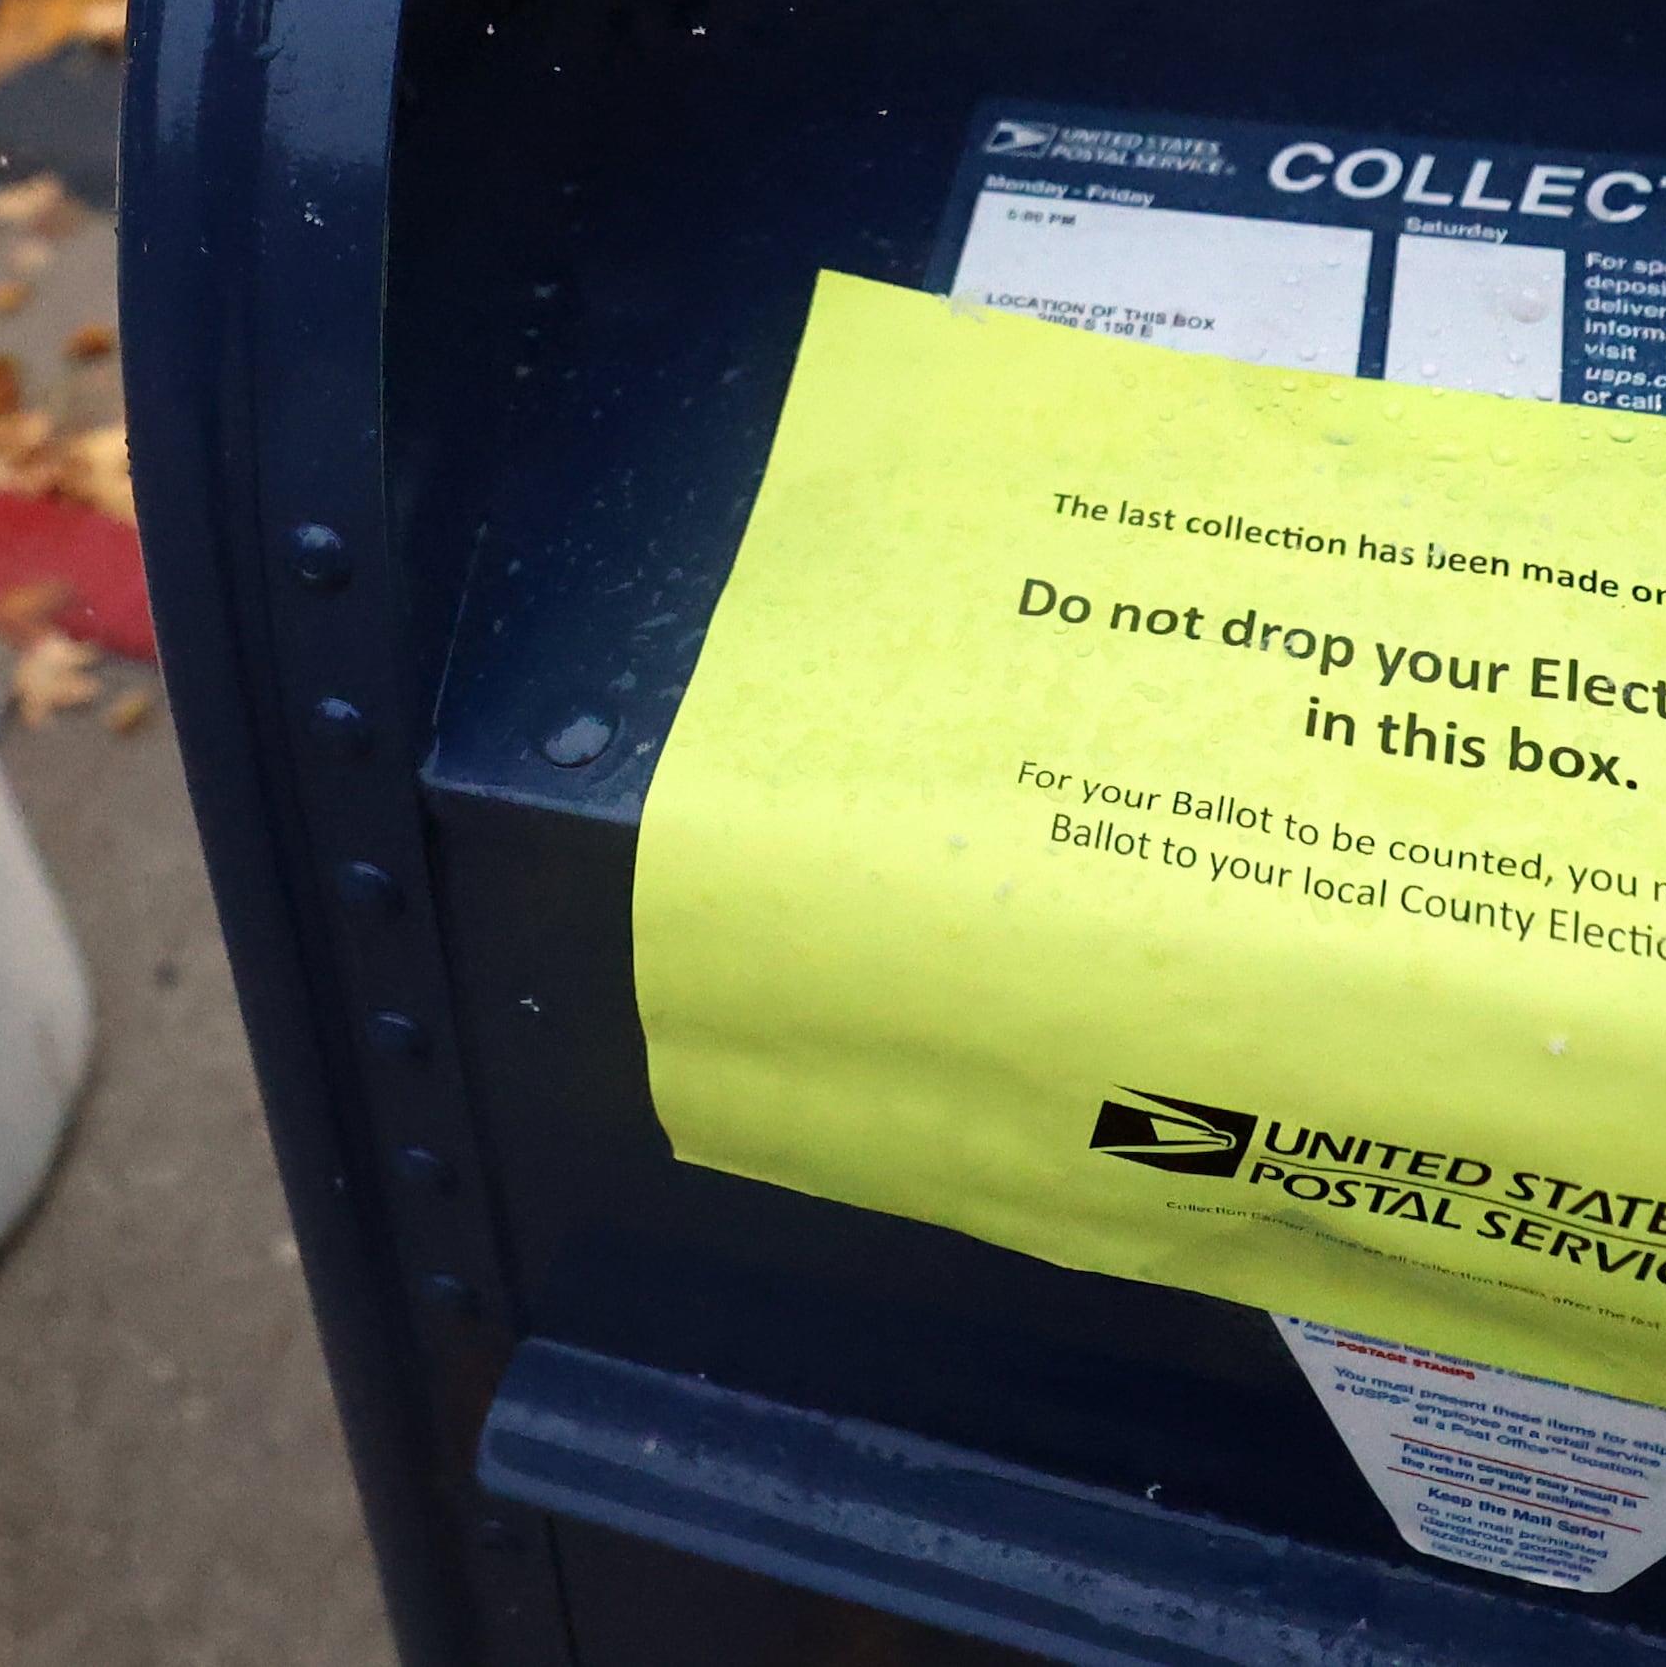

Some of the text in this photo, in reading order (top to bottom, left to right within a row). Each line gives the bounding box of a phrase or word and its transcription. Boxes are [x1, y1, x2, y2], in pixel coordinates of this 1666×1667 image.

[1060, 127, 1223, 156] UNITED STATES
[985, 173, 1069, 199] Monday
[1086, 183, 1155, 207] Friday
[1404, 215, 1508, 245] Saturday
[1585, 251, 1628, 270] For
[986, 291, 1215, 331] LOCATION OF THIS BOX
[1584, 342, 1637, 362] visit
[1583, 389, 1663, 412] or call
[1052, 492, 1109, 522] The
[1117, 500, 1176, 533] last
[1185, 514, 1347, 556] collection
[1357, 533, 1415, 567] has
[1426, 542, 1510, 577] been
[1522, 560, 1620, 598] made
[1018, 577, 1092, 624] Do
[1109, 601, 1204, 641] not
[1221, 609, 1356, 676] drop
[1375, 642, 1510, 694] your
[1305, 696, 1639, 790] in this box.
[1017, 760, 1073, 791] For
[1082, 777, 1162, 812] your
[1171, 790, 1272, 834] Ballot
[1283, 813, 1320, 846] to
[1332, 822, 1376, 855] be
[1389, 839, 1555, 888] counted,
[1567, 862, 1639, 897] you
[1051, 812, 1152, 860] Ballot
[1163, 836, 1198, 869] to
[1209, 850, 1293, 888] your
[1304, 866, 1387, 908] local
[1400, 884, 1535, 942] County
[1263, 1121, 1494, 1187] UNITED
[1166, 1201, 1247, 1218] Collection
[1249, 1161, 1463, 1231] POSTAL
[1336, 1339, 1408, 1365] POSTAGE
[1412, 1358, 1476, 1381] STAMPS
[1333, 1365, 1367, 1383] You
[1371, 1375, 1415, 1395] must
[1419, 1387, 1487, 1413] present
[1492, 1405, 1542, 1426] these
[1547, 1418, 1597, 1439] items
[1602, 1430, 1628, 1446] for
[1415, 1401, 1502, 1432] employee
[1506, 1422, 1525, 1437] at
[1529, 1429, 1541, 1440] a
[1545, 1434, 1590, 1452] retail
[1595, 1446, 1661, 1469] service
[1451, 1423, 1491, 1442] Post
[1401, 1456, 1425, 1471] the
[1429, 1464, 1475, 1483] return
[1479, 1475, 1495, 1486] of
[1498, 1481, 1532, 1497] your
[1403, 1442, 1638, 1510] Failure to comply may result in
[1428, 1487, 1474, 1509] Keep
[1478, 1499, 1507, 1517] the
[1513, 1508, 1553, 1528] Mail
[1416, 1502, 1609, 1560] Do not mail prohibited
[1420, 1524, 1508, 1556] hazardous
[1423, 1515, 1514, 1546] dangerous
